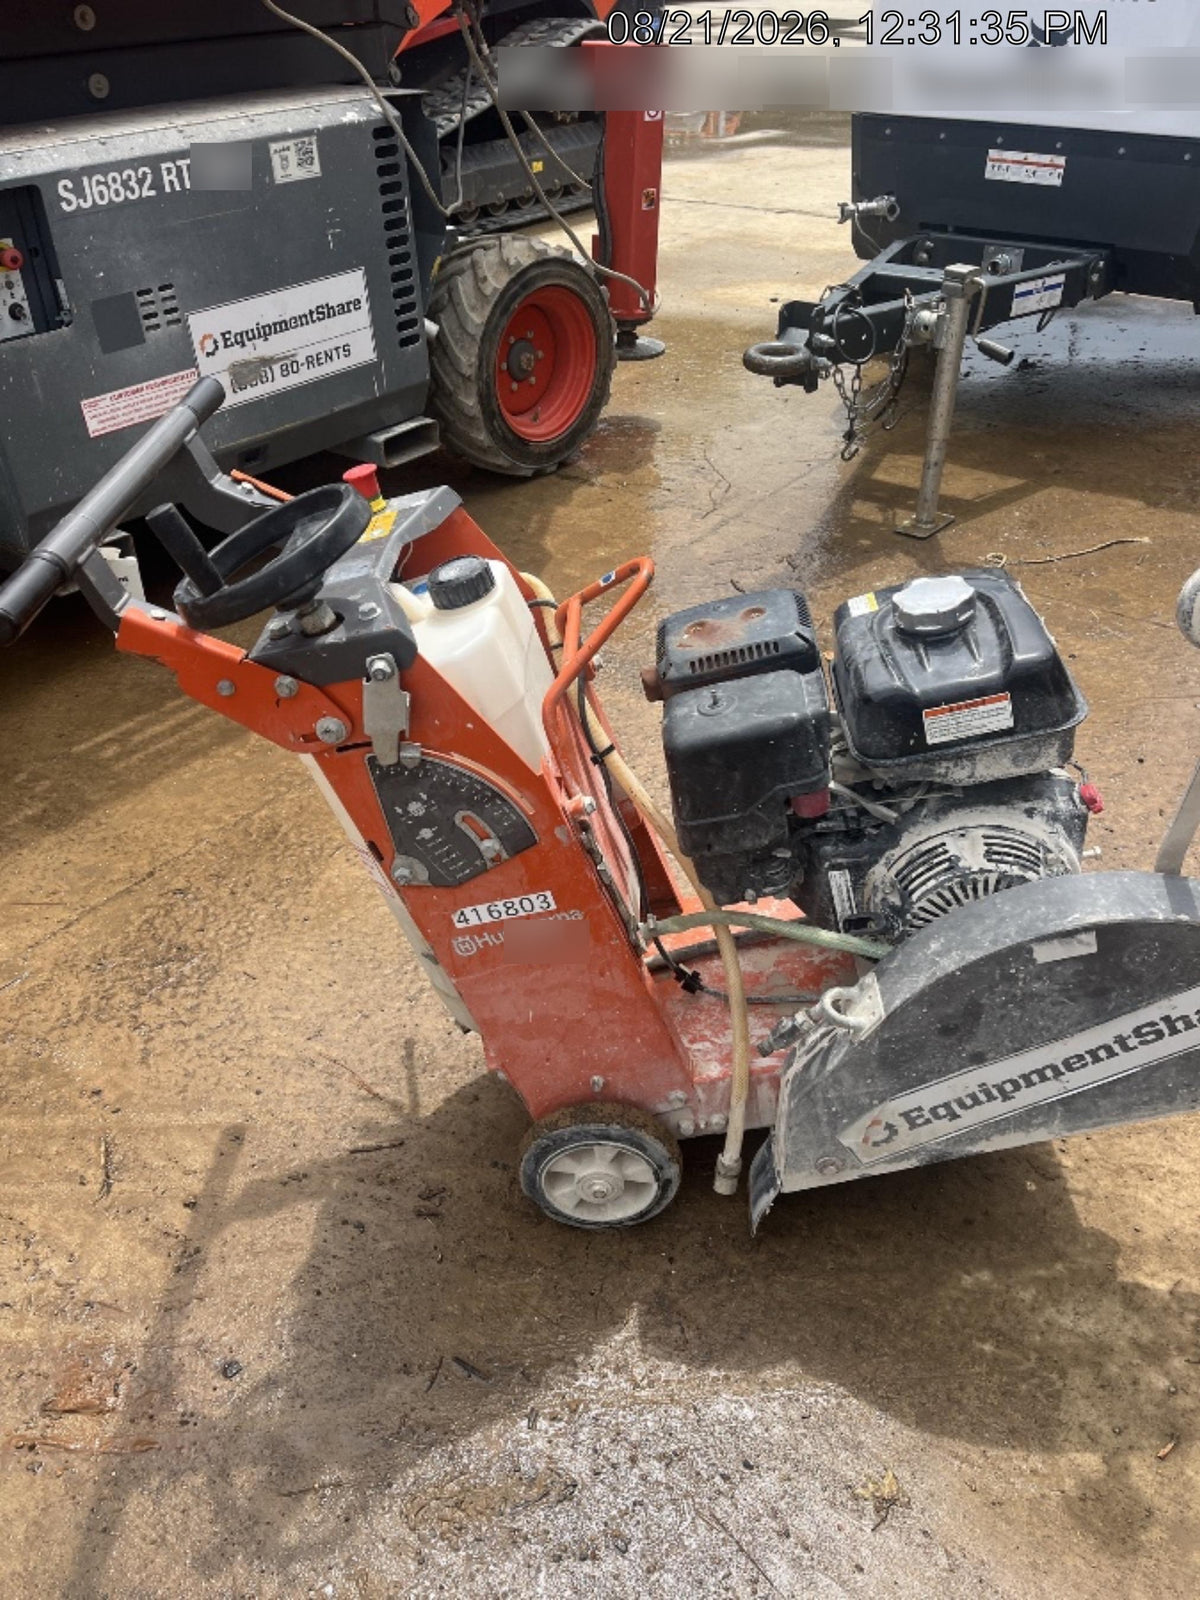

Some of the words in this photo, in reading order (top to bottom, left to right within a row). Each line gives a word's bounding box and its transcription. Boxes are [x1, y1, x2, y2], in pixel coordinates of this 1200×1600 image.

[58, 166, 157, 212] SJ6832
[220, 298, 362, 349] EquipmentShare
[280, 343, 352, 378] 80-RENTS
[456, 893, 552, 925] 416803
